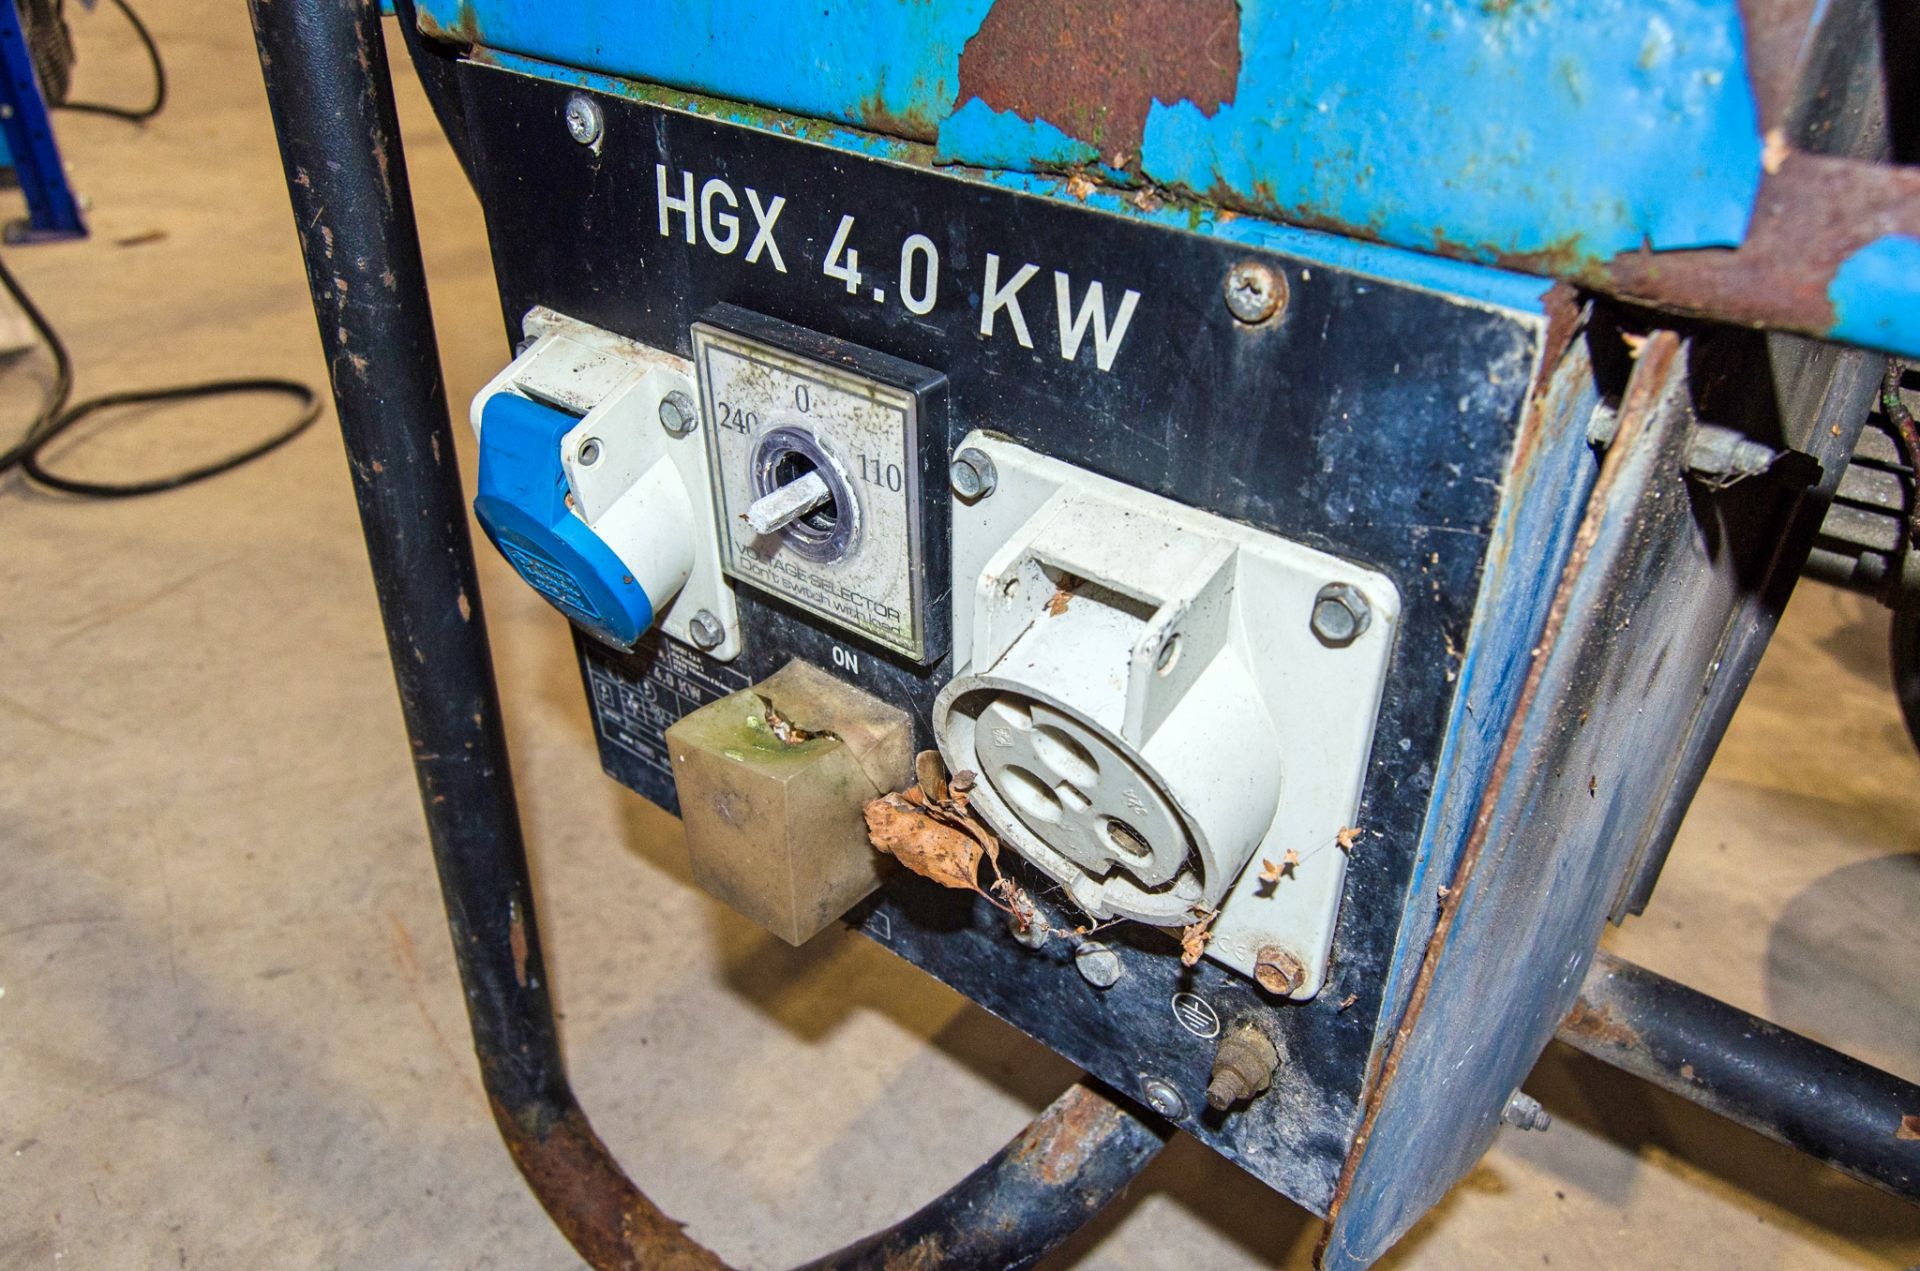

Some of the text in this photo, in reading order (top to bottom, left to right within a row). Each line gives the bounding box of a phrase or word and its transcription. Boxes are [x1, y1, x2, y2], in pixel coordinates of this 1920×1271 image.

[656, 164, 1141, 372] HGX 4.0 KW
[794, 384, 811, 413] 0
[859, 454, 902, 493] 110
[740, 556, 780, 584] Don't
[810, 574, 900, 624] SELECTOR
[831, 646, 859, 675] ON
[654, 666, 674, 688] 4.0
[678, 679, 701, 702] KW
